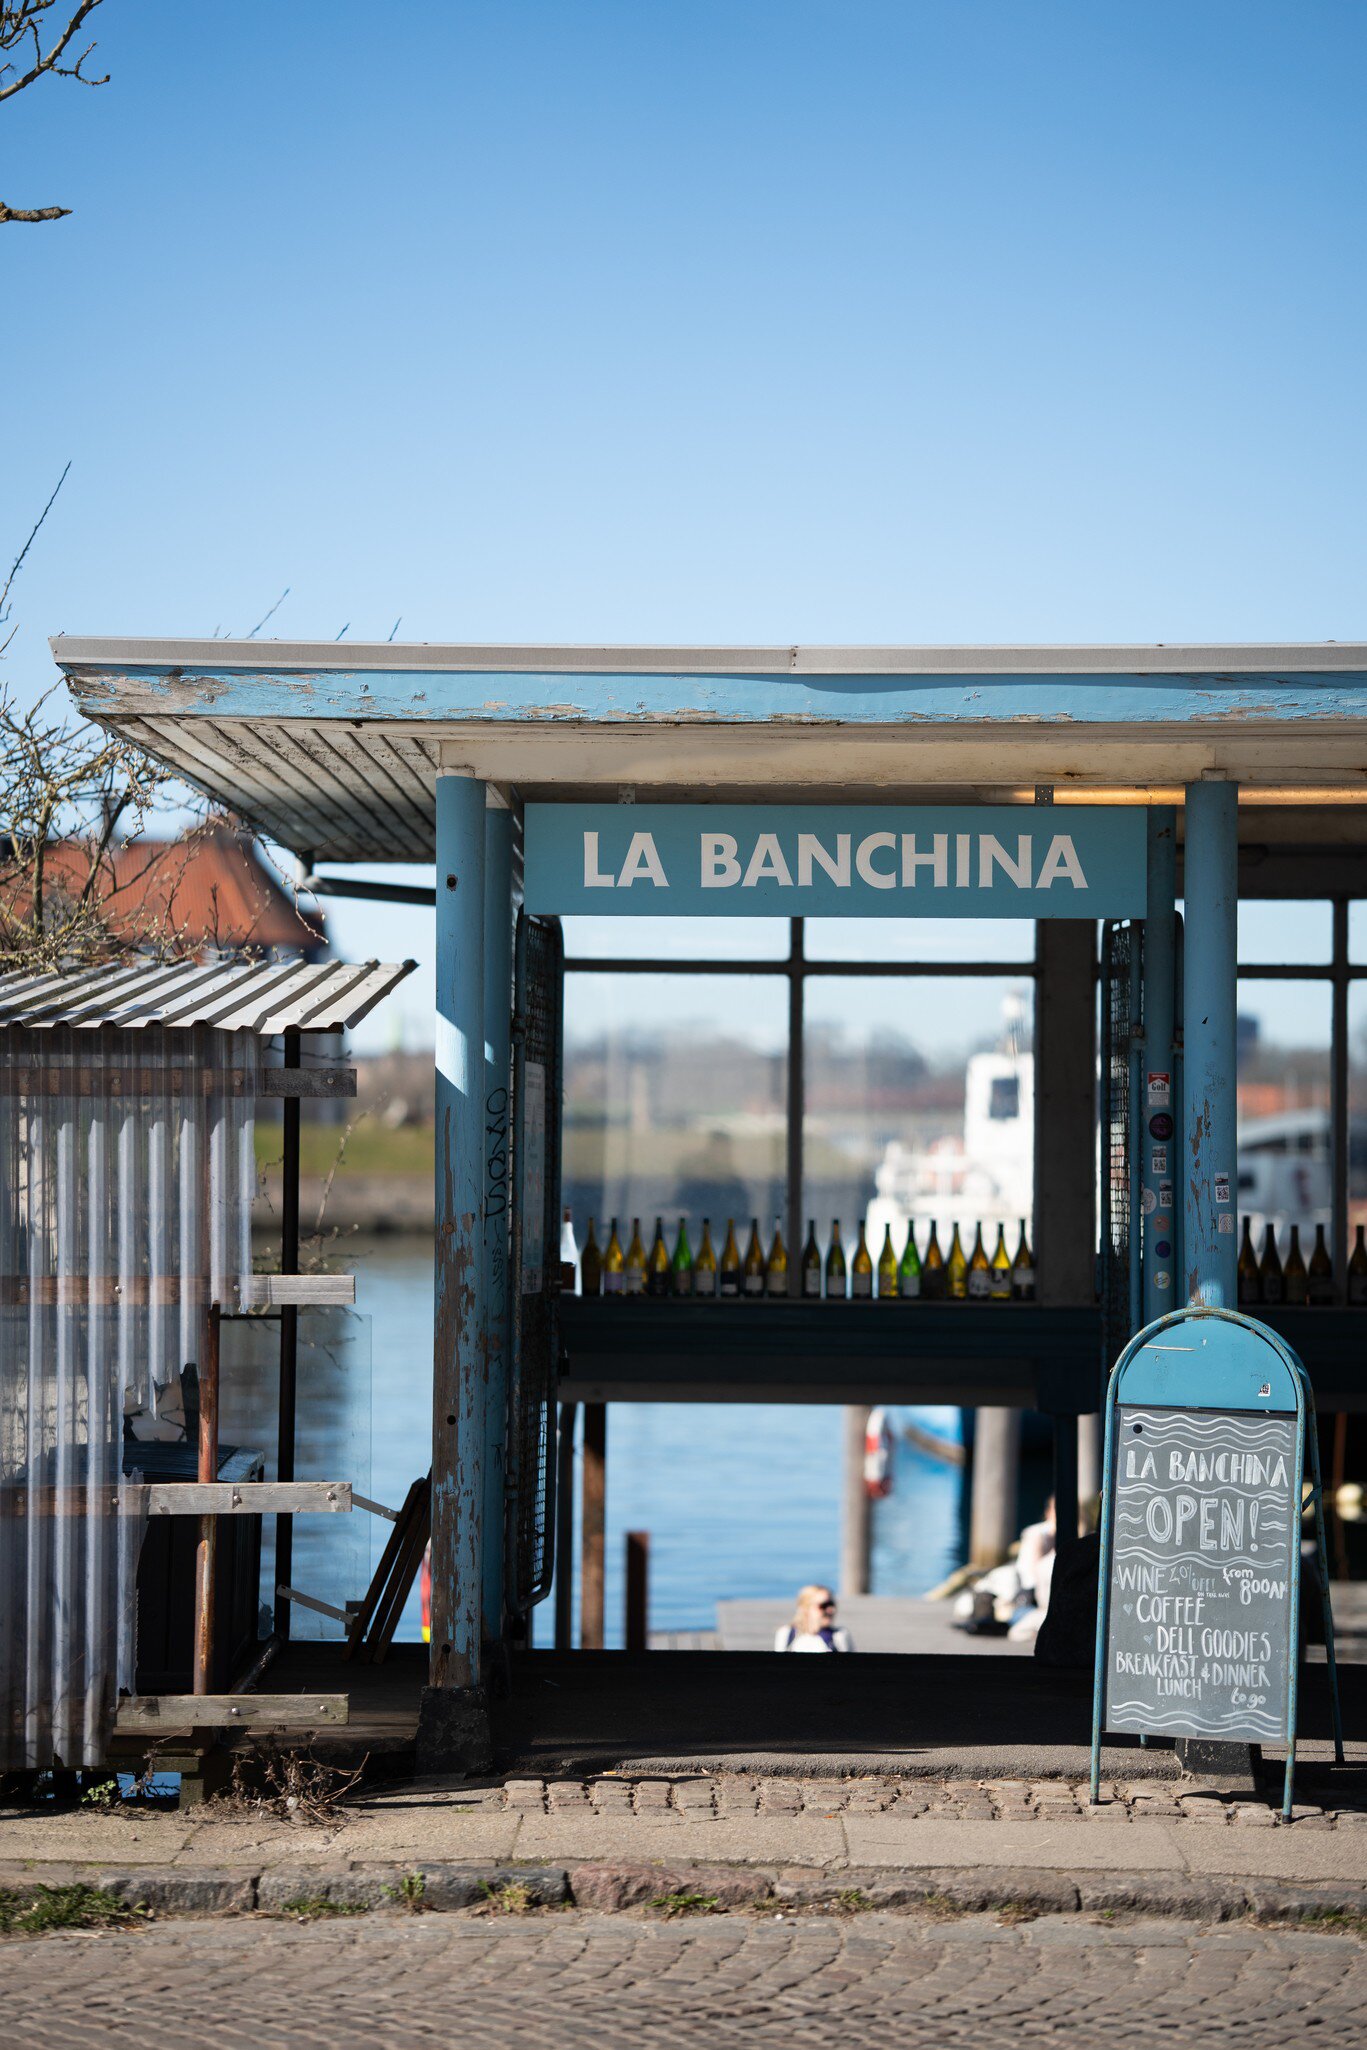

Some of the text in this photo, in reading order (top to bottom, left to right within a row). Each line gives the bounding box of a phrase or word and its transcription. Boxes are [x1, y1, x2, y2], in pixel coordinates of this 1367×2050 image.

[583, 831, 1089, 889] LA BANCHINA
[1126, 1450, 1289, 1488] LA BANCHINA
[1146, 1495, 1259, 1552] OPEN!
[1117, 1564, 1169, 1594] WINE
[1191, 1577, 1216, 1592] OFF!
[1222, 1567, 1254, 1586] from
[1136, 1594, 1206, 1625] COFFEE
[1156, 1625, 1271, 1662] DELI GOODIES
[1116, 1651, 1271, 1687] BREAKFAST & DINNER
[1156, 1677, 1202, 1700] LUNCH
[1231, 1687, 1266, 1709] to go
